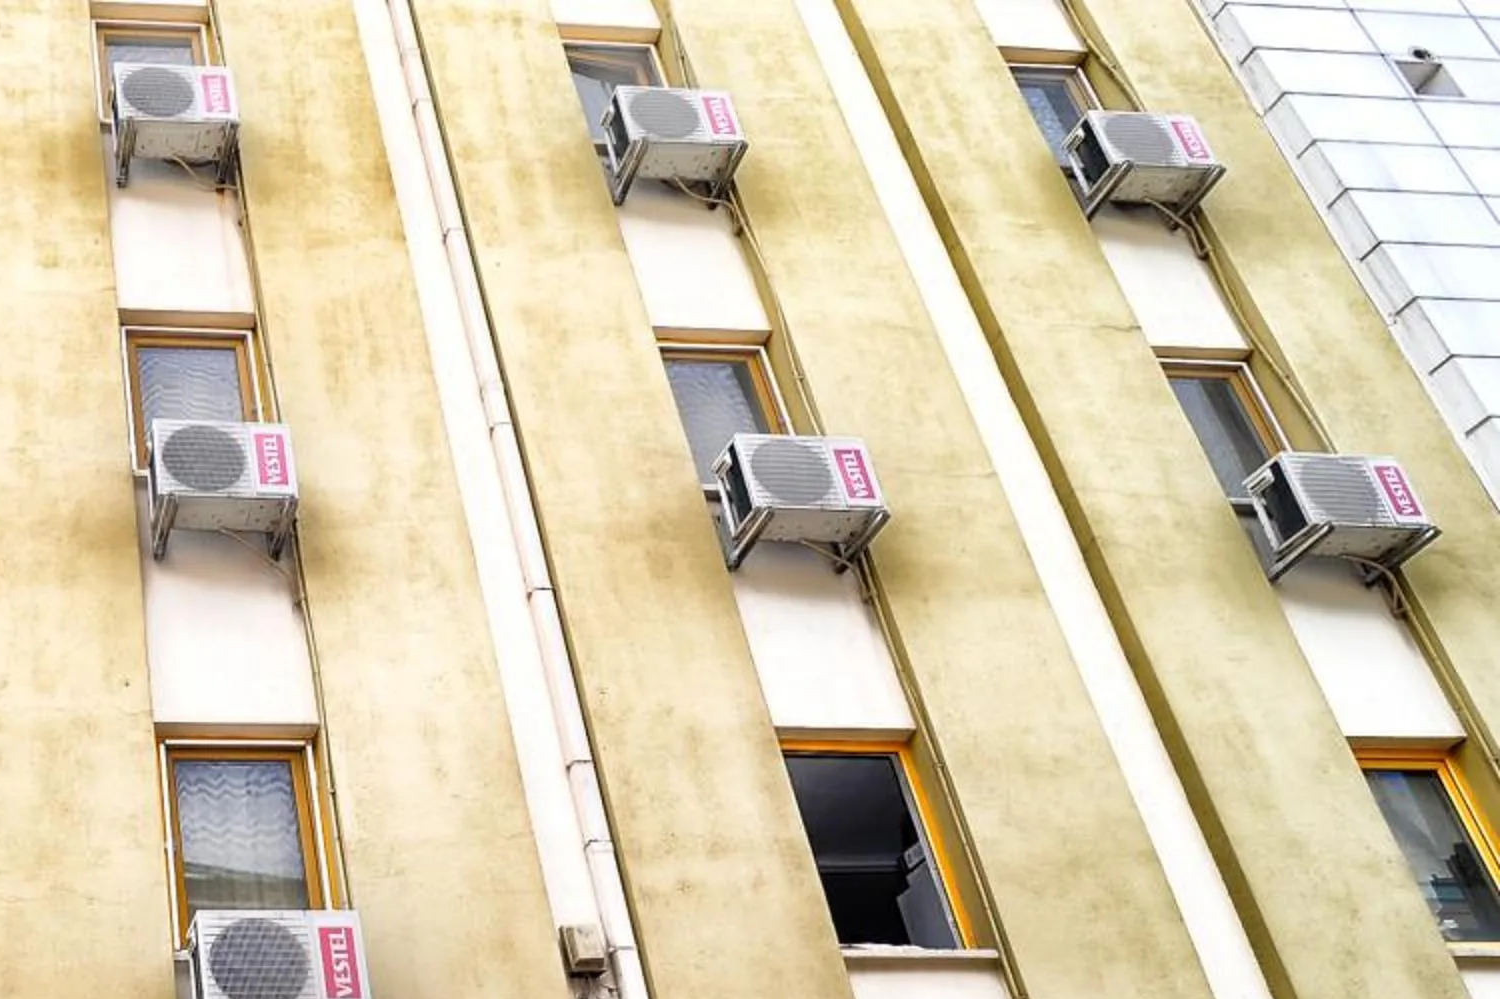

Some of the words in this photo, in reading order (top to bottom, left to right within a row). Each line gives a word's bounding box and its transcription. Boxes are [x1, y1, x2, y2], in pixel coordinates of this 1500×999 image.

[260, 434, 283, 484] VESTEL
[841, 450, 871, 497] VESTEL
[328, 928, 354, 997] VESTEL
